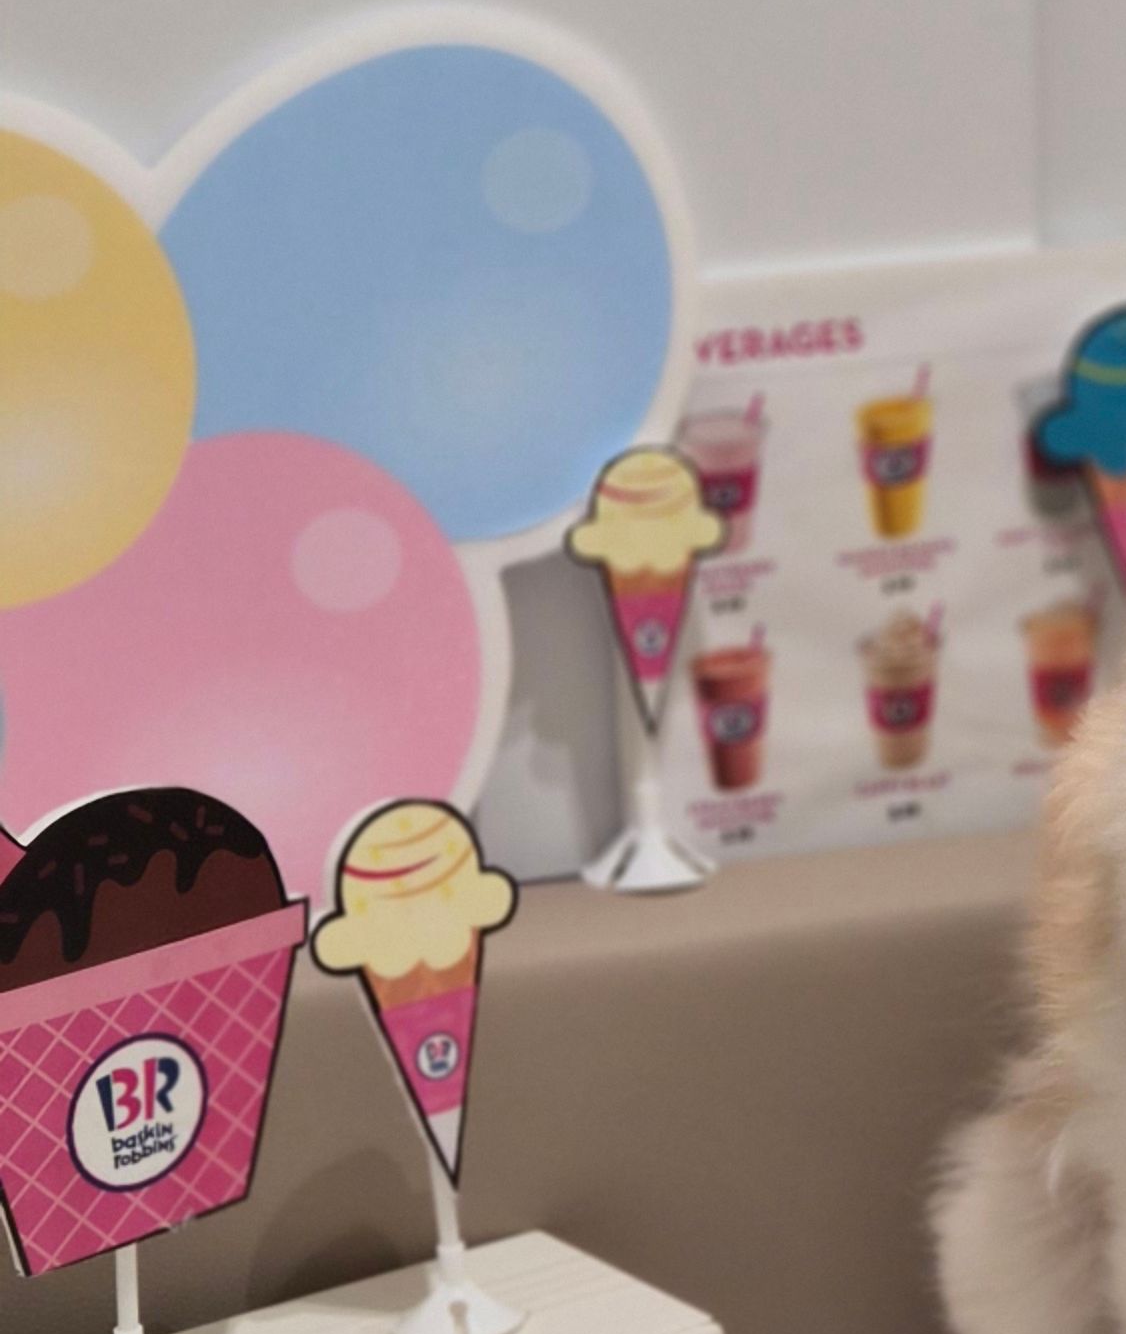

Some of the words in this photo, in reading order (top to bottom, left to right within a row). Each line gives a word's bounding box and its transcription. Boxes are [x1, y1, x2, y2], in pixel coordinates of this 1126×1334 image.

[95, 1057, 180, 1132] BR
[111, 1122, 174, 1153] baskin
[113, 1137, 177, 1170] robbins
